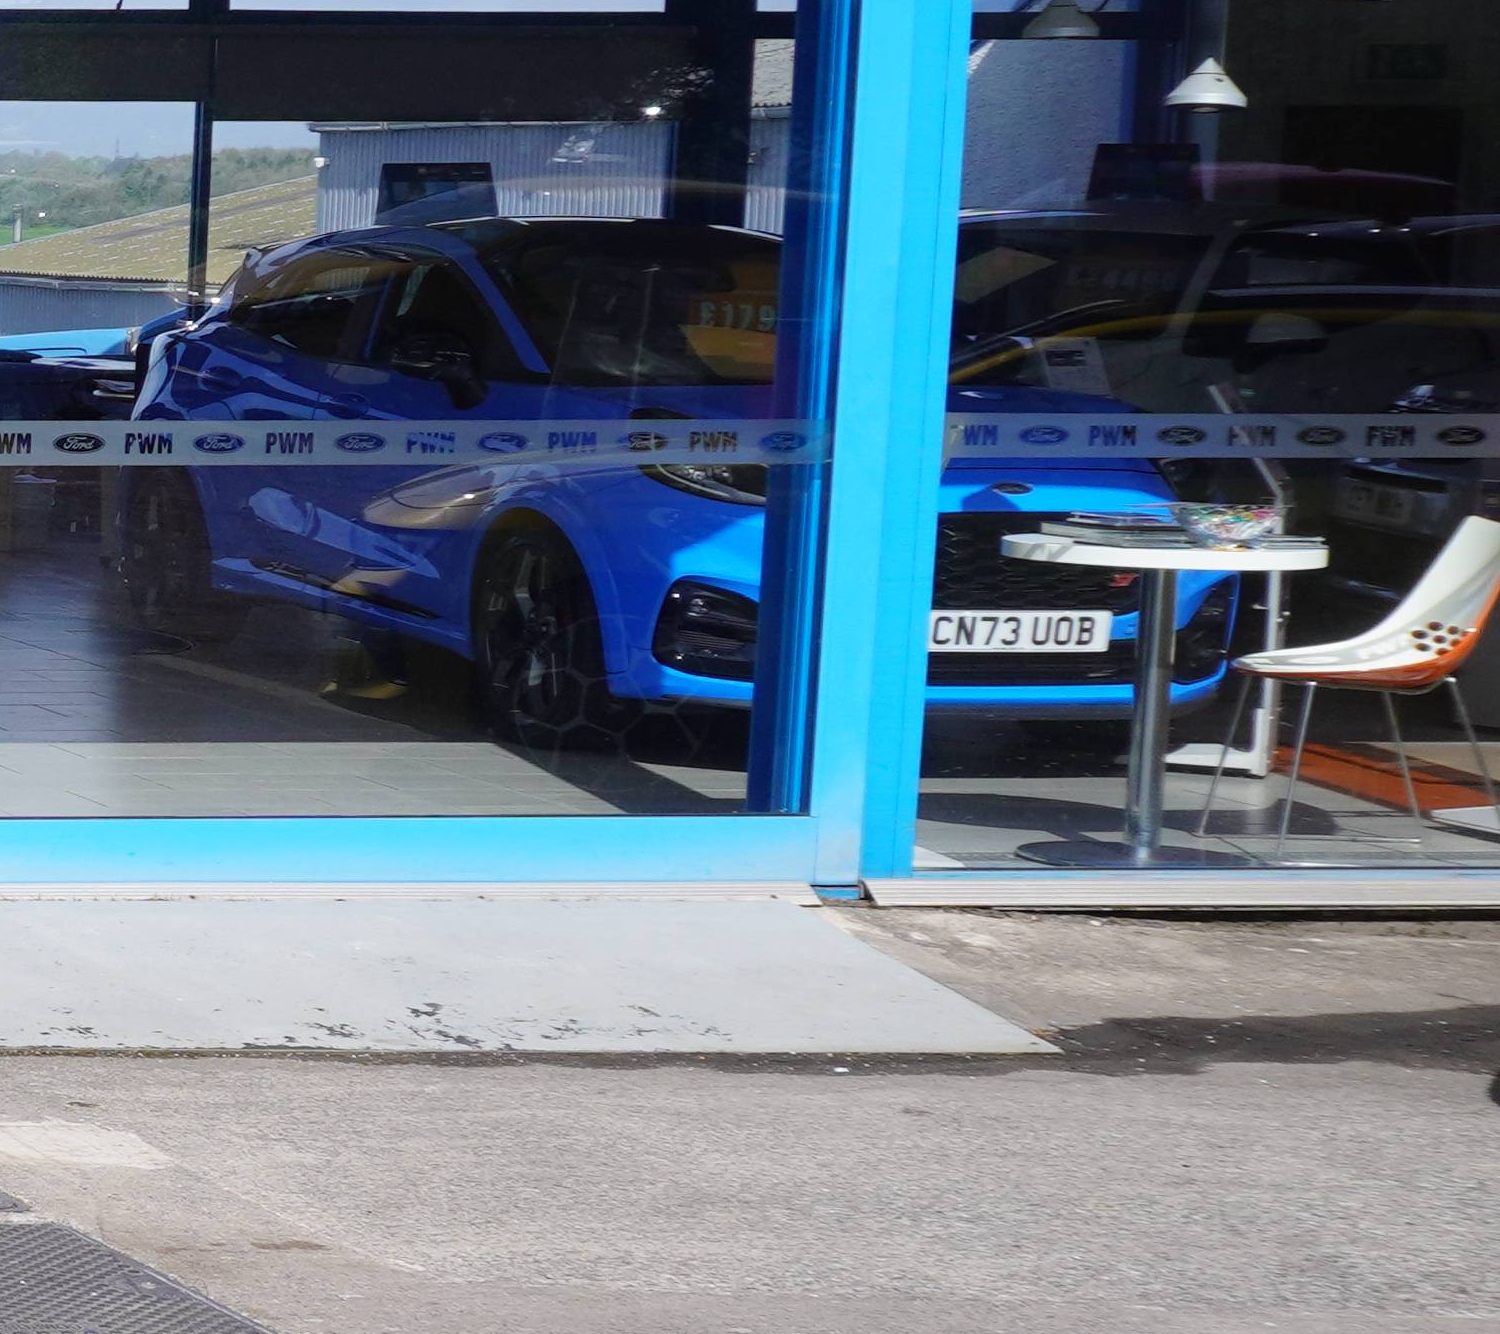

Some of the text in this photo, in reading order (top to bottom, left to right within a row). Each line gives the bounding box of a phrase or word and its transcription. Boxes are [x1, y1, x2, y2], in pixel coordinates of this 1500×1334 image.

[124, 433, 172, 454] PWM
[265, 432, 314, 453] PWM
[406, 432, 455, 453] PWM
[548, 431, 596, 452] PWM
[689, 431, 738, 453] PWM
[1088, 425, 1137, 446] PWM
[932, 616, 1096, 646] CN73 UOB
